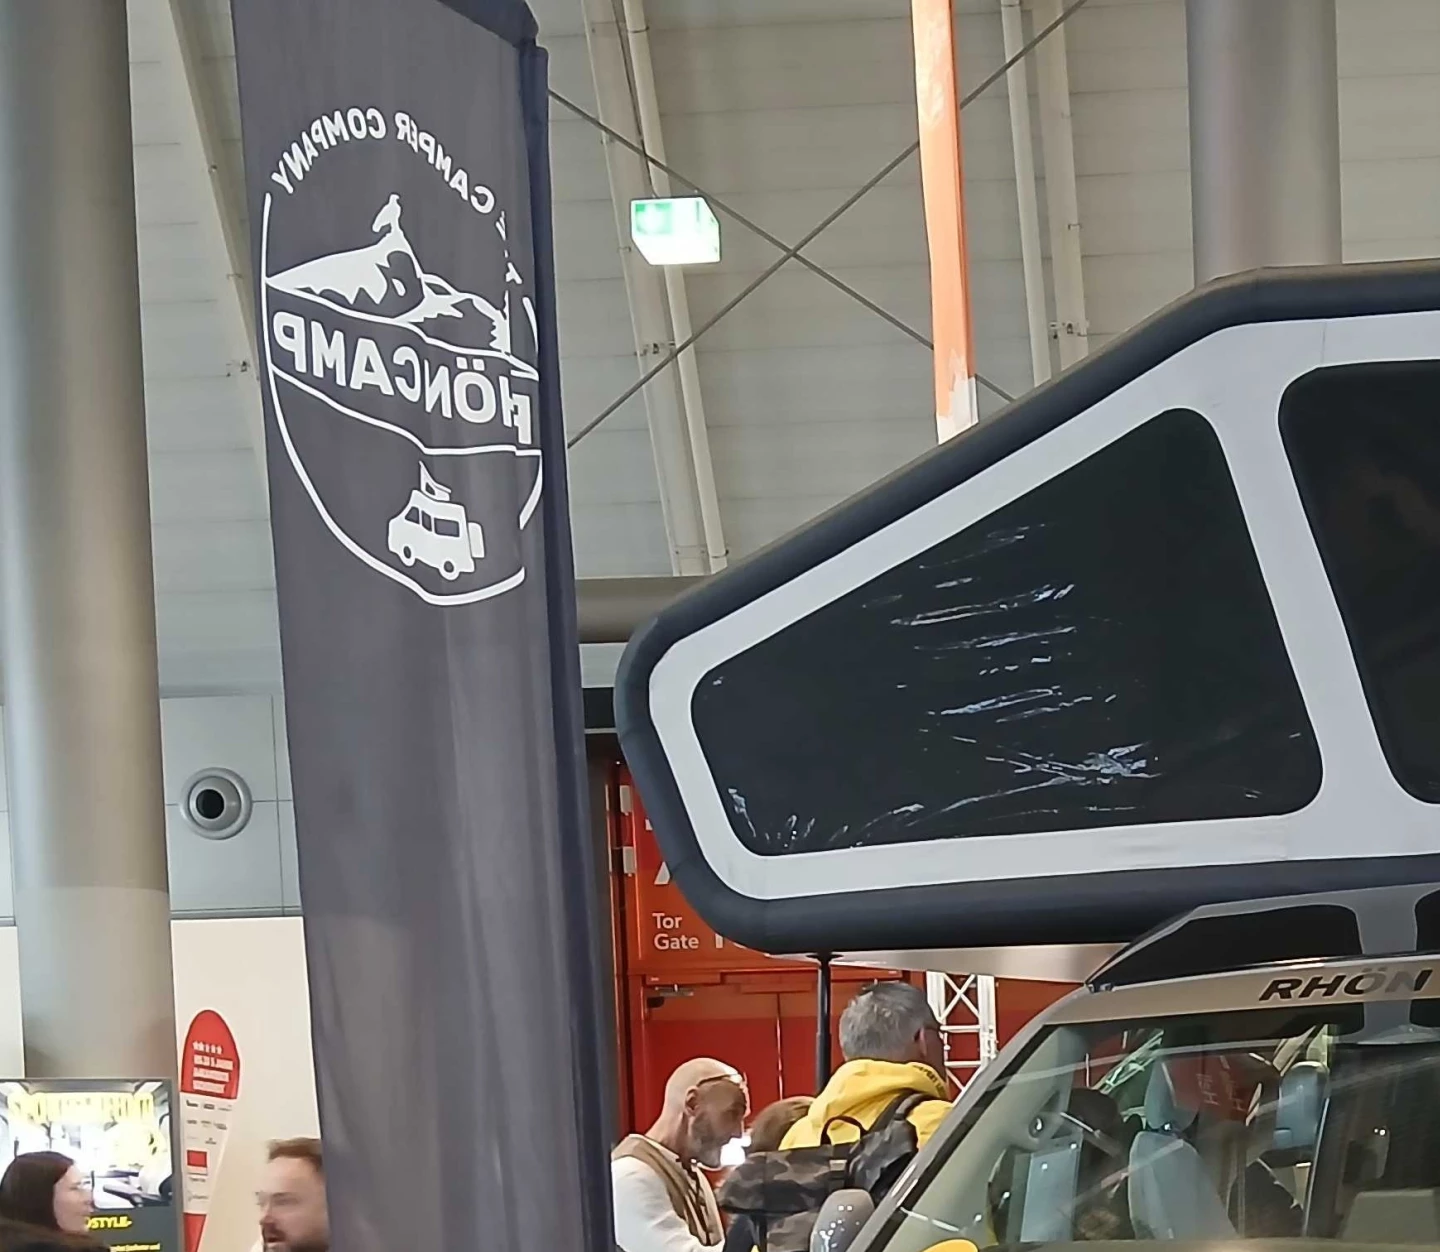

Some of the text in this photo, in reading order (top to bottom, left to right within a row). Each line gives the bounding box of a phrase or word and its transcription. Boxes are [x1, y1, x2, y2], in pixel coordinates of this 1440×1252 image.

[652, 912, 683, 930] Tor
[653, 933, 700, 950] Gate
[1258, 966, 1433, 1002] RHÖN
